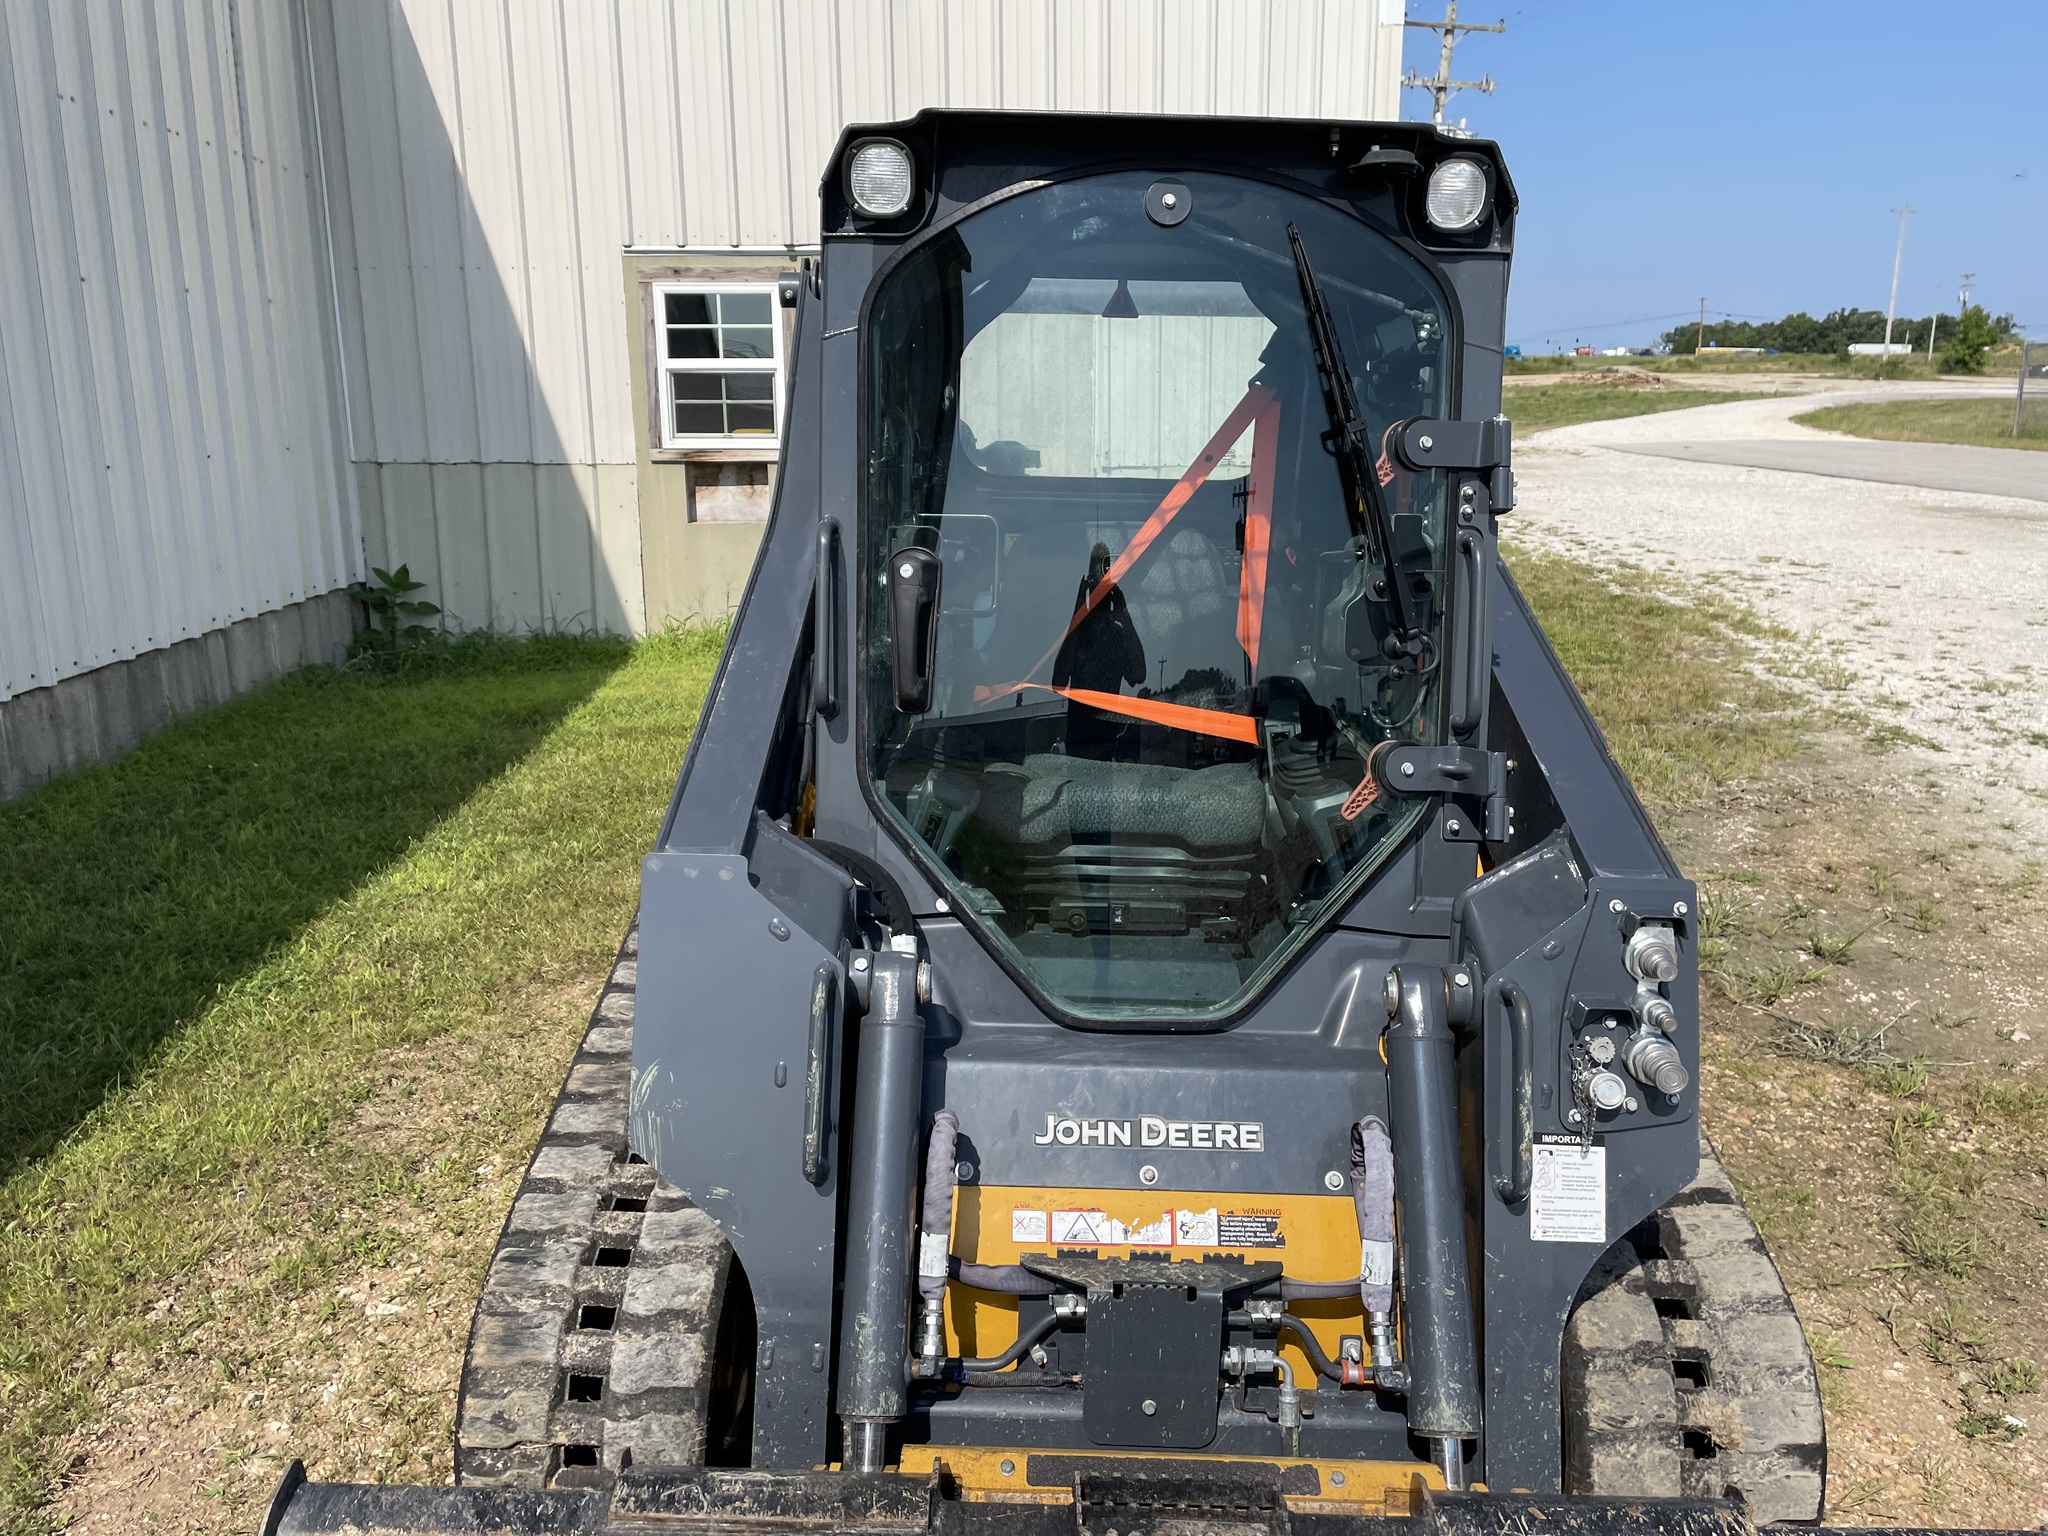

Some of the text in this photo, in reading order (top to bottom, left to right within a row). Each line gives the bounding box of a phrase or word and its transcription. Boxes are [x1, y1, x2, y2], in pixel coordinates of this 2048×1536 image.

[1035, 1115, 1261, 1149] JOHN DEERE
[1542, 1135, 1593, 1144] IMPORTA
[1243, 1208, 1282, 1216] WARNING
